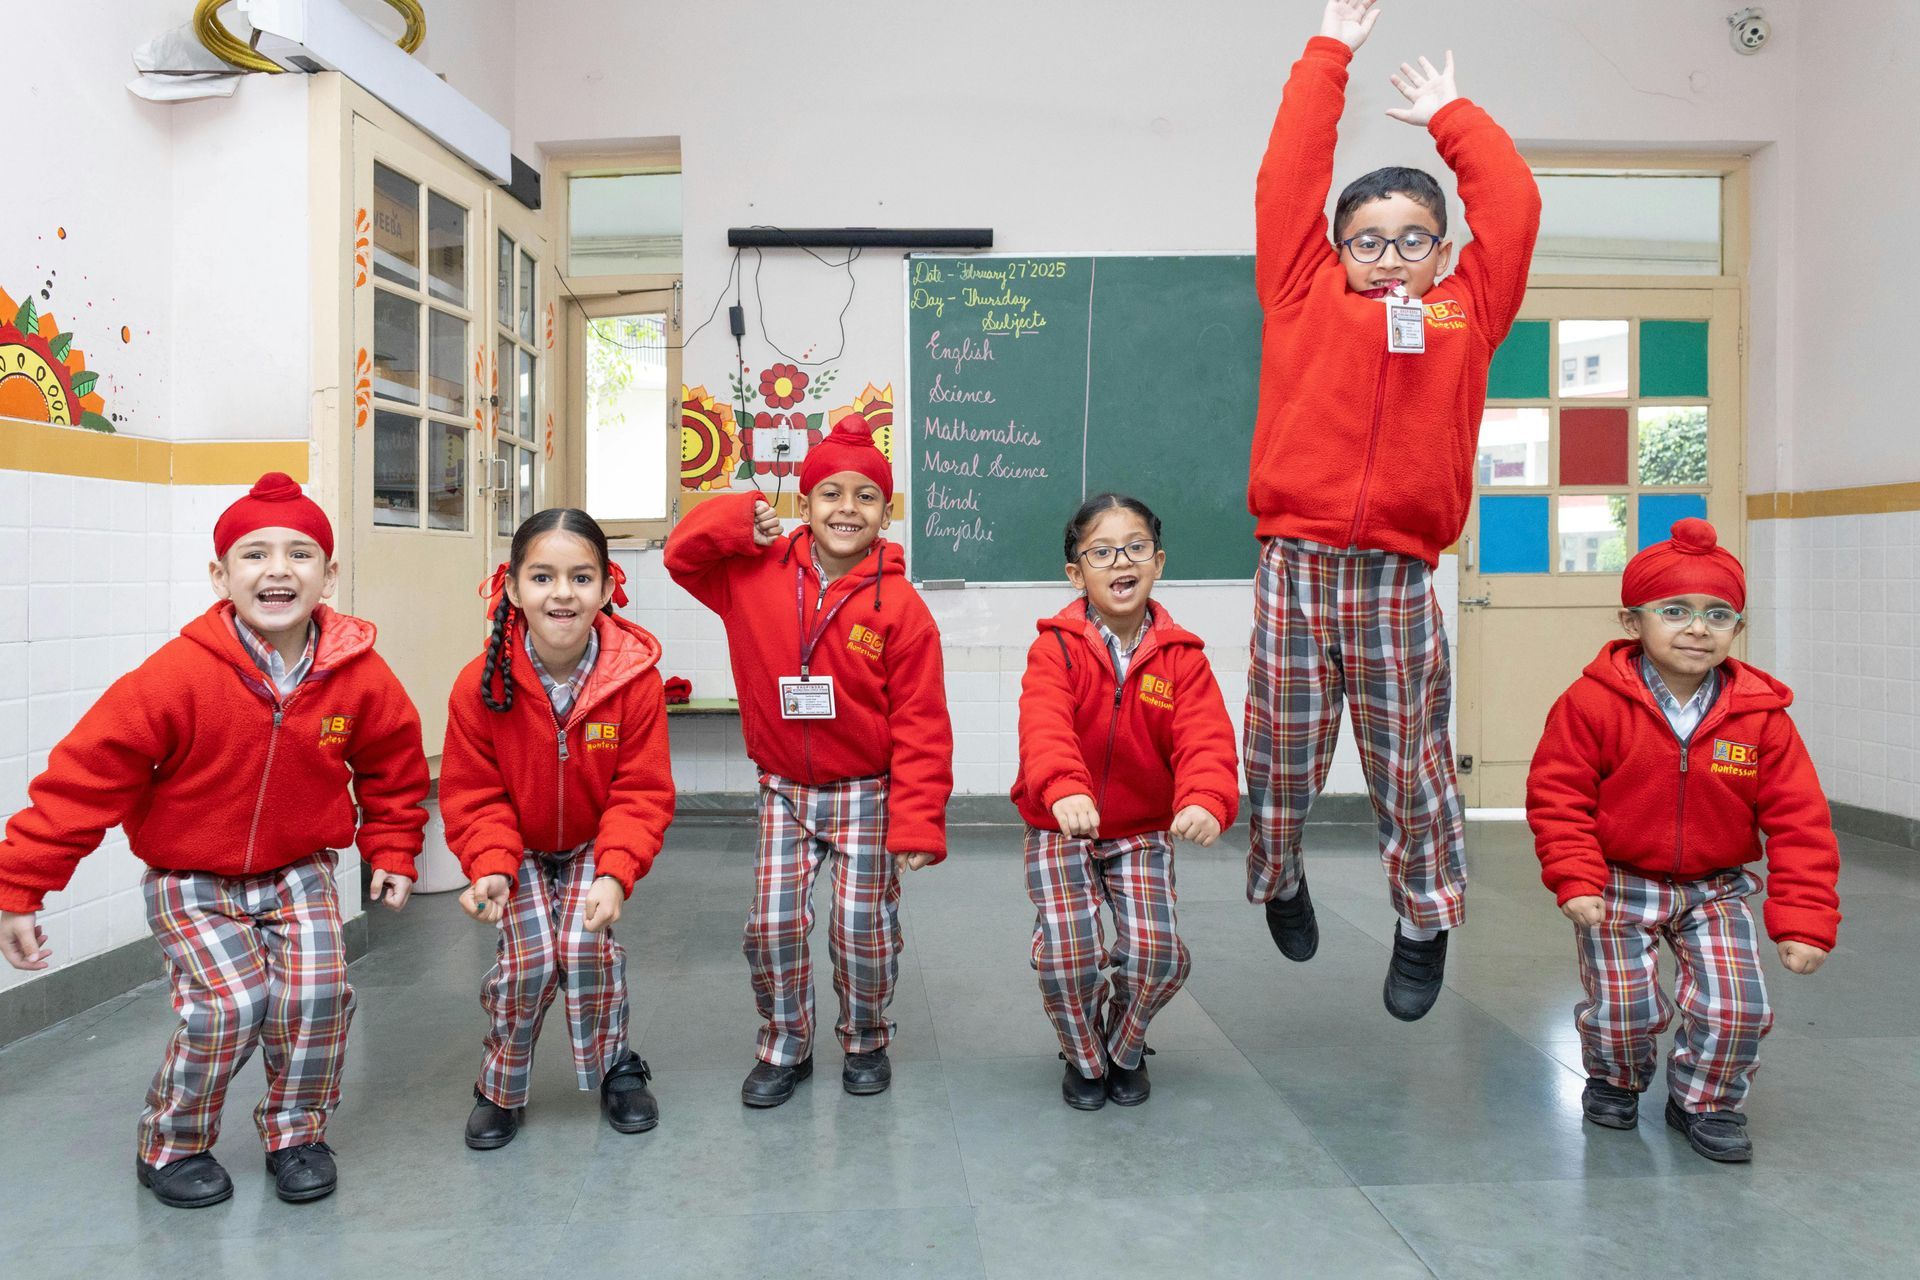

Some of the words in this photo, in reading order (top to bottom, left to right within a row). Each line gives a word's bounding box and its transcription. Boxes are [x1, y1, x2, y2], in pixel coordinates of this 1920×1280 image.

[913, 261, 945, 286] Date
[956, 261, 1007, 290] February
[911, 288, 944, 318] Day
[962, 287, 1031, 312] Thursday
[982, 310, 1047, 338] Subjects
[926, 330, 994, 375] English
[929, 374, 996, 403] Science
[924, 416, 1041, 446] Mathematics
[921, 450, 982, 478] Moral
[987, 453, 1049, 478] Science
[925, 481, 981, 511] Hindi
[925, 511, 995, 552] Punjabi
